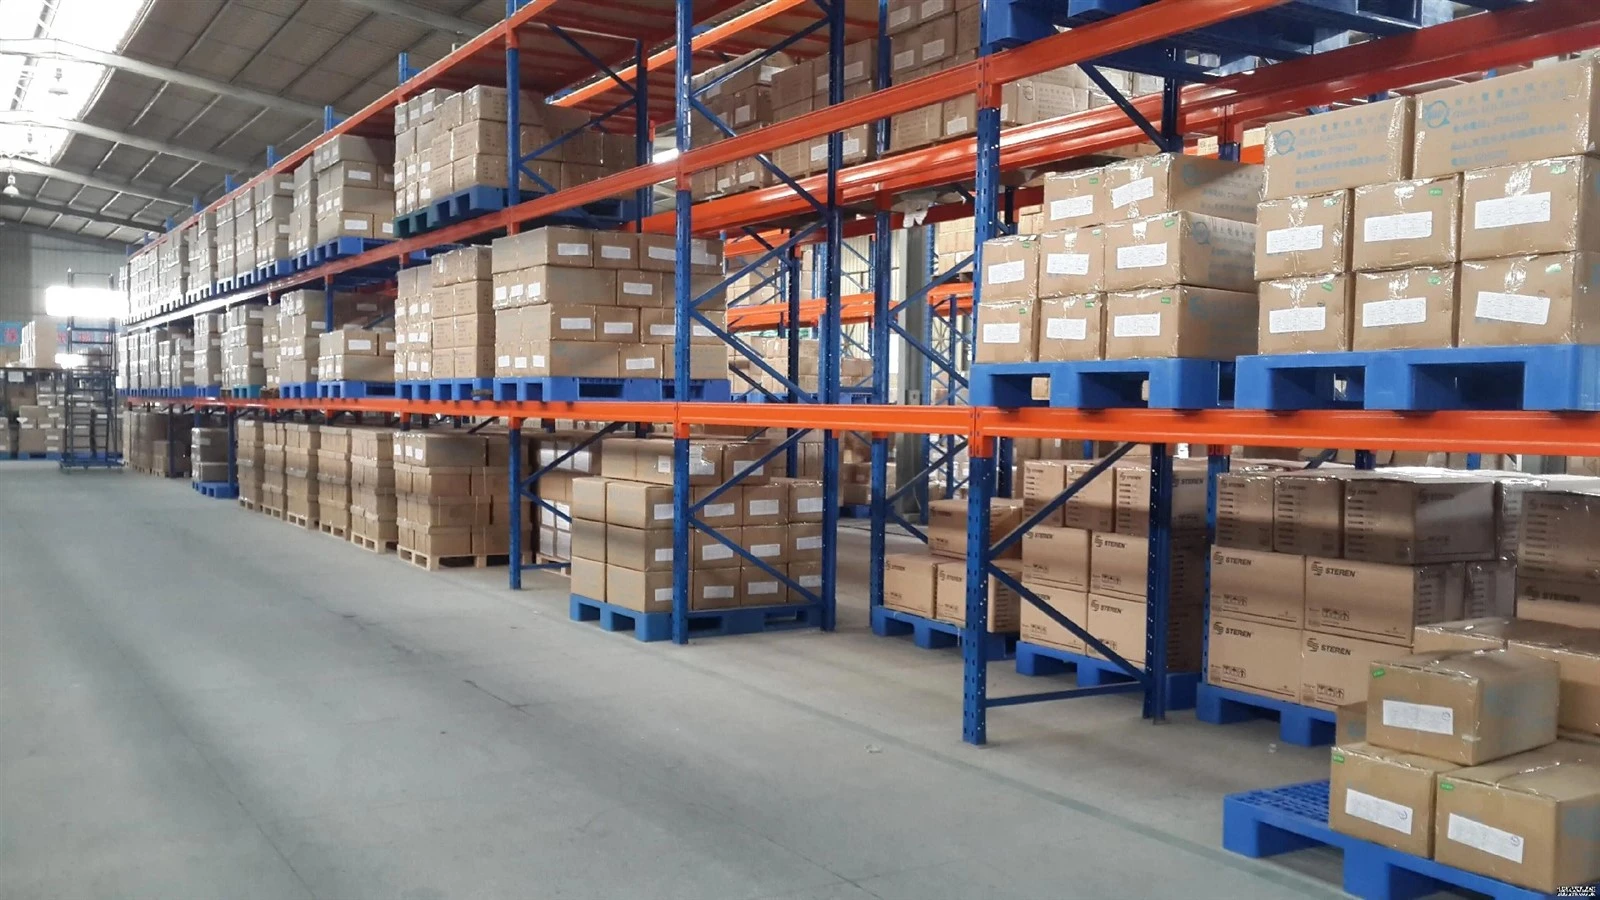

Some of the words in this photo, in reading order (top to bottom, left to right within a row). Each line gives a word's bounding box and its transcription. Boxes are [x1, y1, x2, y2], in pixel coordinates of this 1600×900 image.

[1104, 540, 1125, 549] STEREN
[1225, 556, 1252, 566] STEREN
[1325, 567, 1356, 578] STEREN
[1100, 605, 1122, 614] STEREN
[1225, 627, 1252, 638] STEREN
[1321, 644, 1351, 656] STEREN
